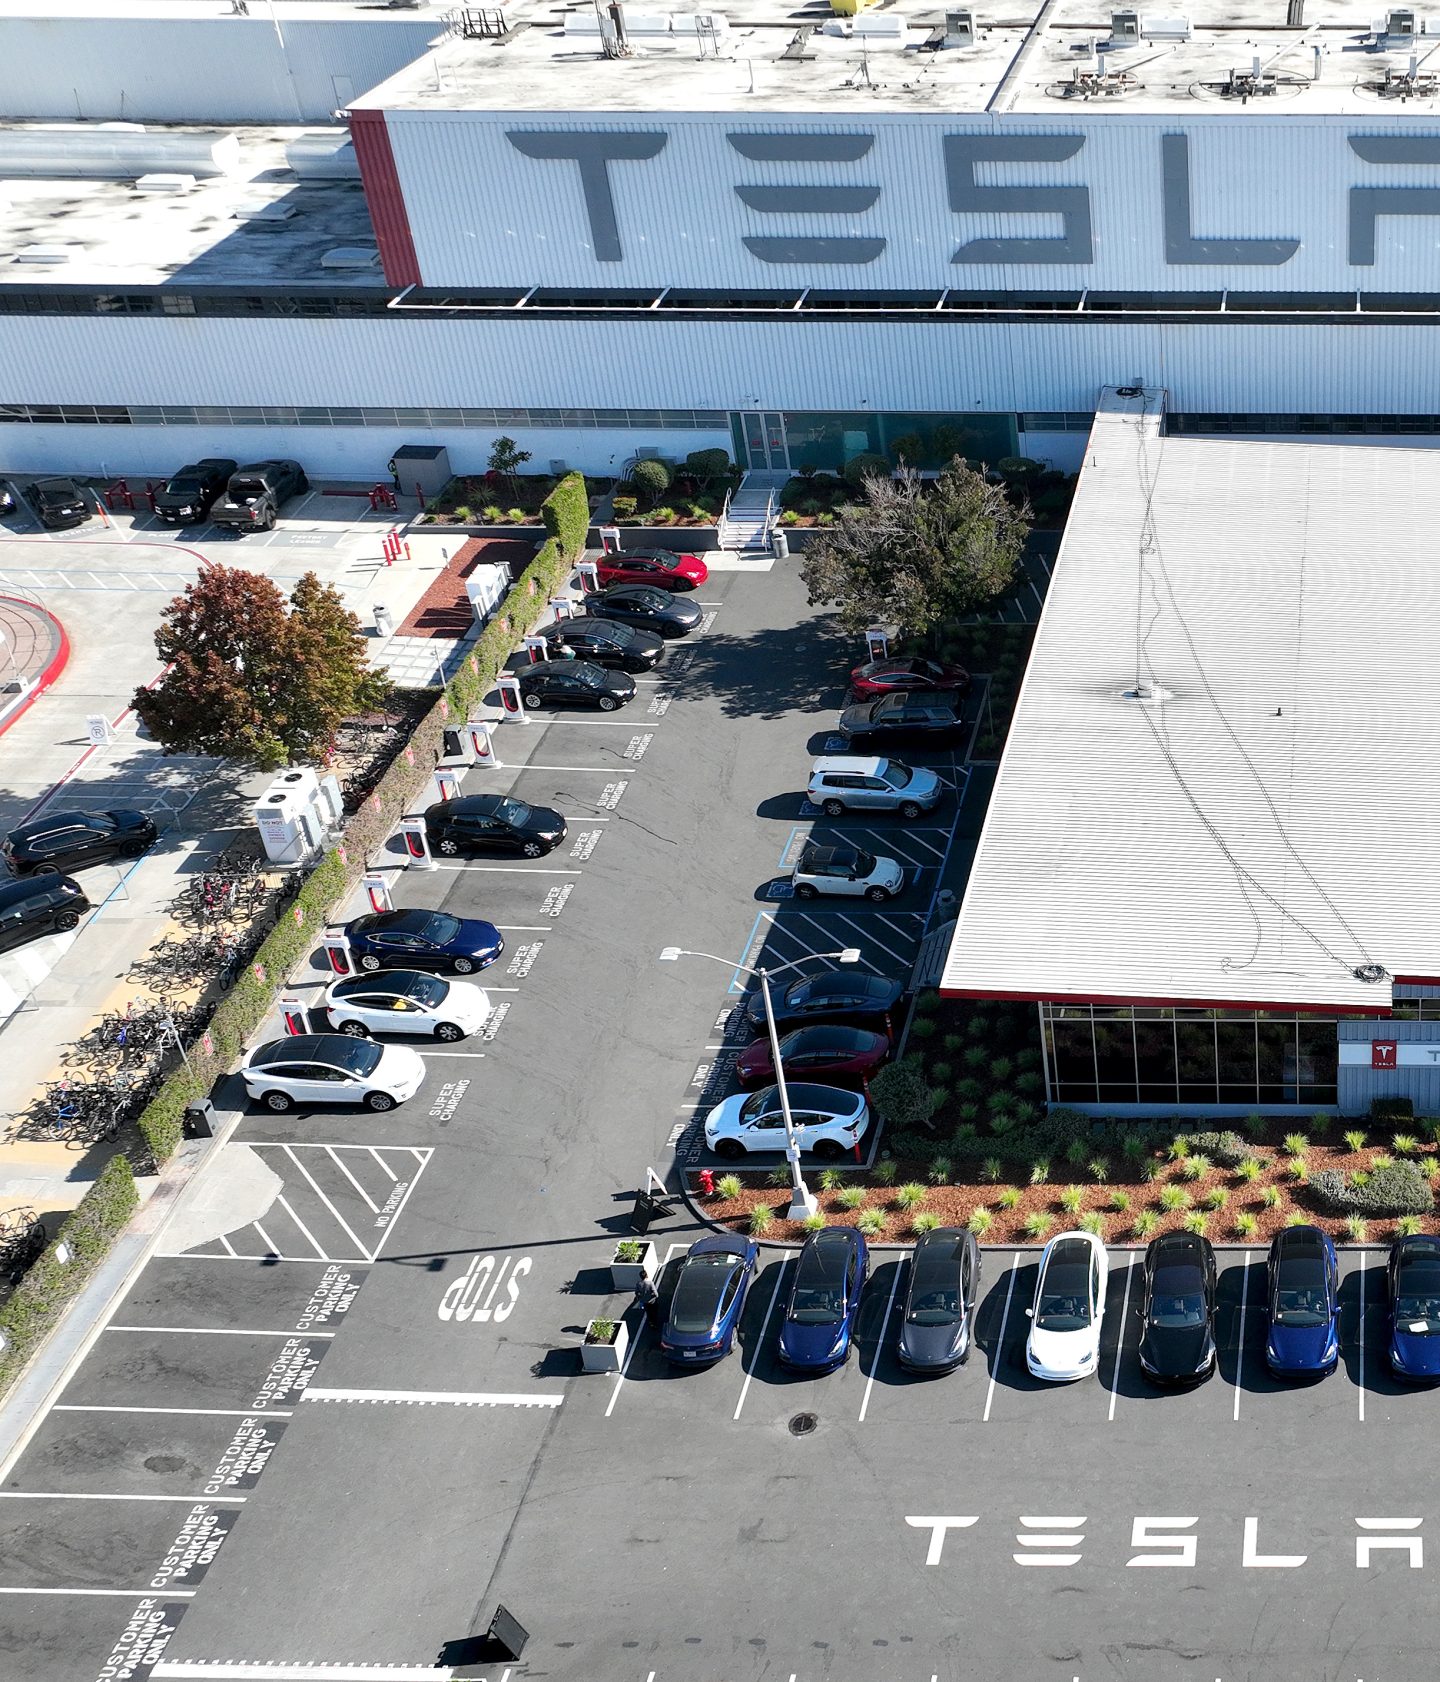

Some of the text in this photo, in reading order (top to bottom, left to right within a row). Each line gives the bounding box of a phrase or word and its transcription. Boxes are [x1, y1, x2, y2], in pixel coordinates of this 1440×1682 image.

[569, 832, 590, 857] SUPER
[579, 829, 603, 860] CHARGING
[539, 887, 562, 913] SUPER
[549, 883, 574, 917] CHARGING
[507, 945, 530, 974] SUPER
[517, 942, 543, 978] CHARGING
[482, 1002, 511, 1041] CHARGING
[714, 1008, 731, 1031] ONLY
[724, 1002, 746, 1037] PARKING
[690, 1064, 709, 1088] ONLY
[701, 1057, 724, 1095] PARKING
[711, 1051, 739, 1105] CUSTOMER
[429, 1083, 456, 1117] SUPER
[440, 1079, 471, 1121] CHARGING
[665, 1123, 686, 1148] ONLY
[676, 1116, 701, 1156] PARKING
[374, 1182, 408, 1227] NO PARKING
[296, 1264, 342, 1330] CUSTOMER
[315, 1273, 351, 1322] PARKING
[335, 1283, 361, 1313] ONLY
[438, 1255, 533, 1323] STOP
[252, 1338, 301, 1409] CUSTOMER
[273, 1347, 311, 1399] PARKING
[293, 1358, 320, 1390] ONLY
[204, 1418, 258, 1493] CUSTOMER
[225, 1429, 267, 1485] PARKING
[247, 1440, 276, 1473] ONLY
[150, 1504, 210, 1588] CUSTOMER
[173, 1515, 219, 1577] PARKING
[197, 1527, 228, 1565] ONLY
[905, 1515, 1424, 1568] TESLA
[116, 1611, 166, 1679] PARKING
[142, 1624, 175, 1665] ONLY
